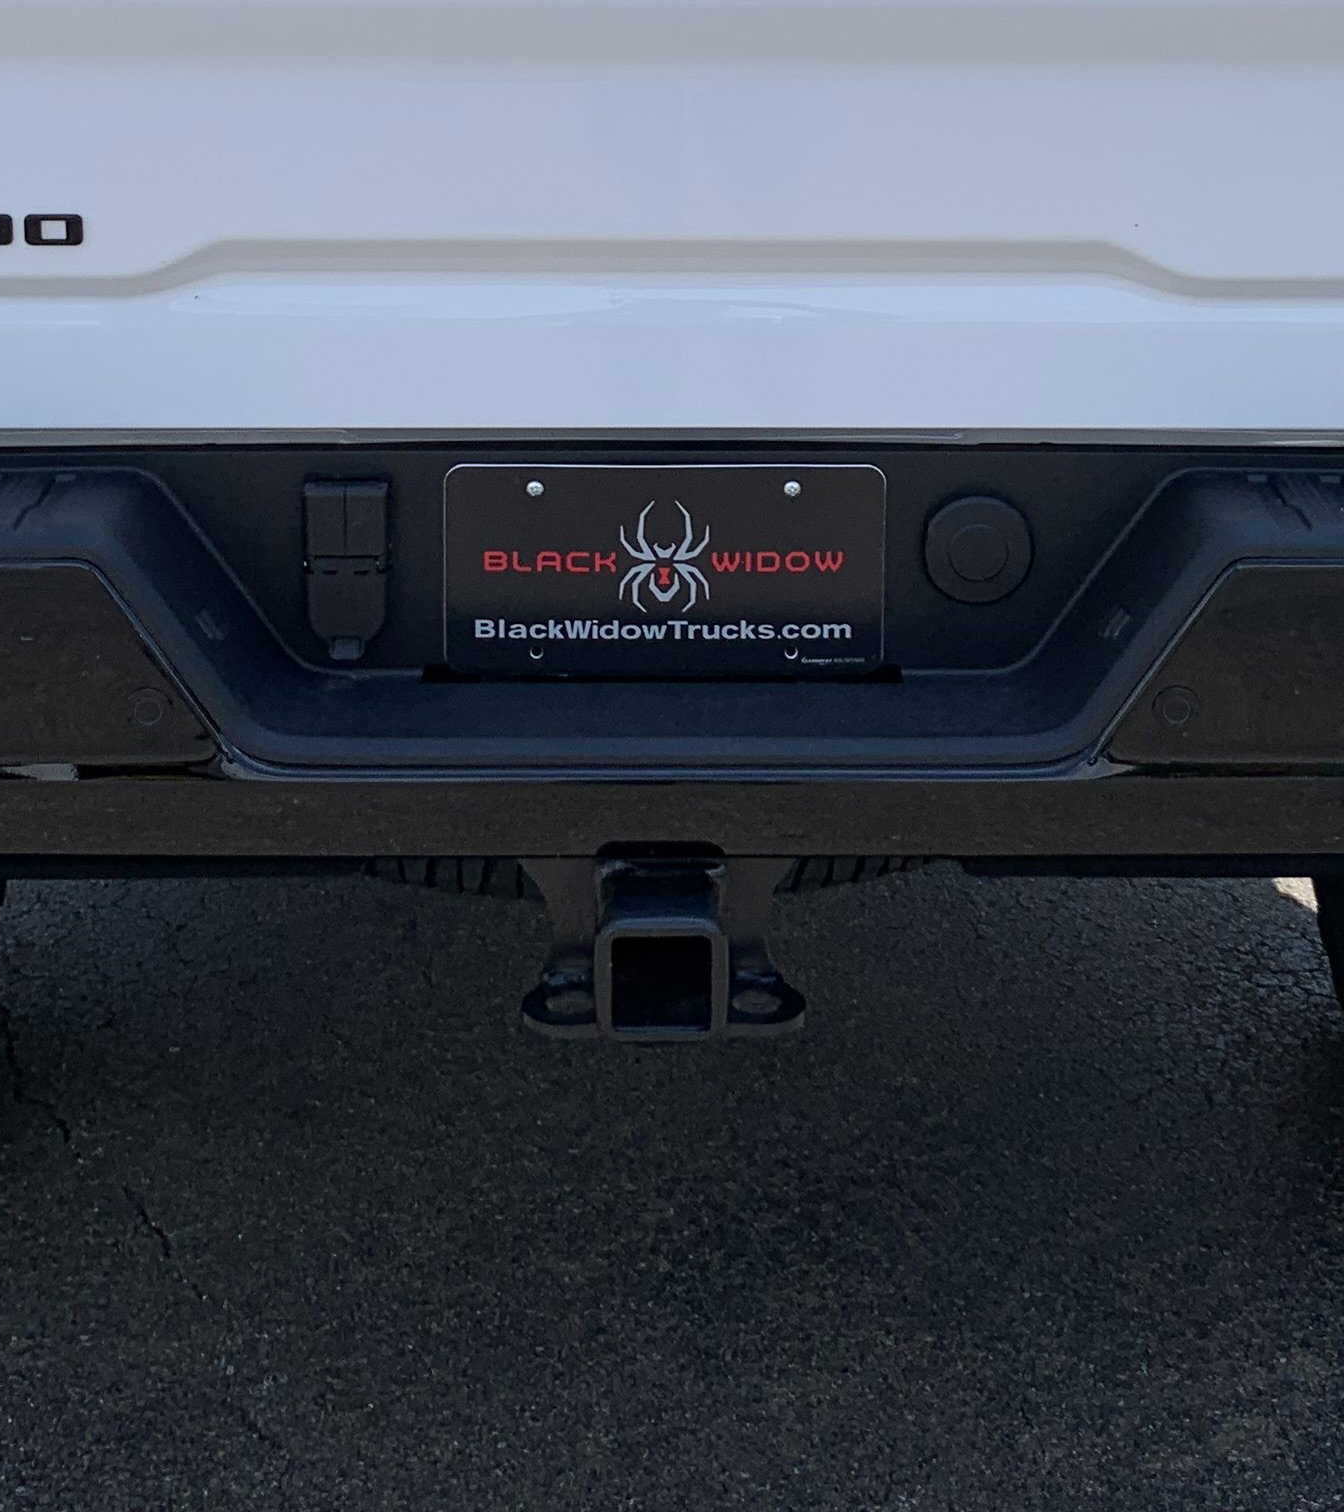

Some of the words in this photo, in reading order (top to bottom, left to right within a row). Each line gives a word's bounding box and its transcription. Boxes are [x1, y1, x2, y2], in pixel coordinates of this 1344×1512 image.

[482, 550, 617, 573] BLACK
[710, 550, 845, 574] WIDOW
[473, 618, 853, 641] BlackWidowTrucks.com
